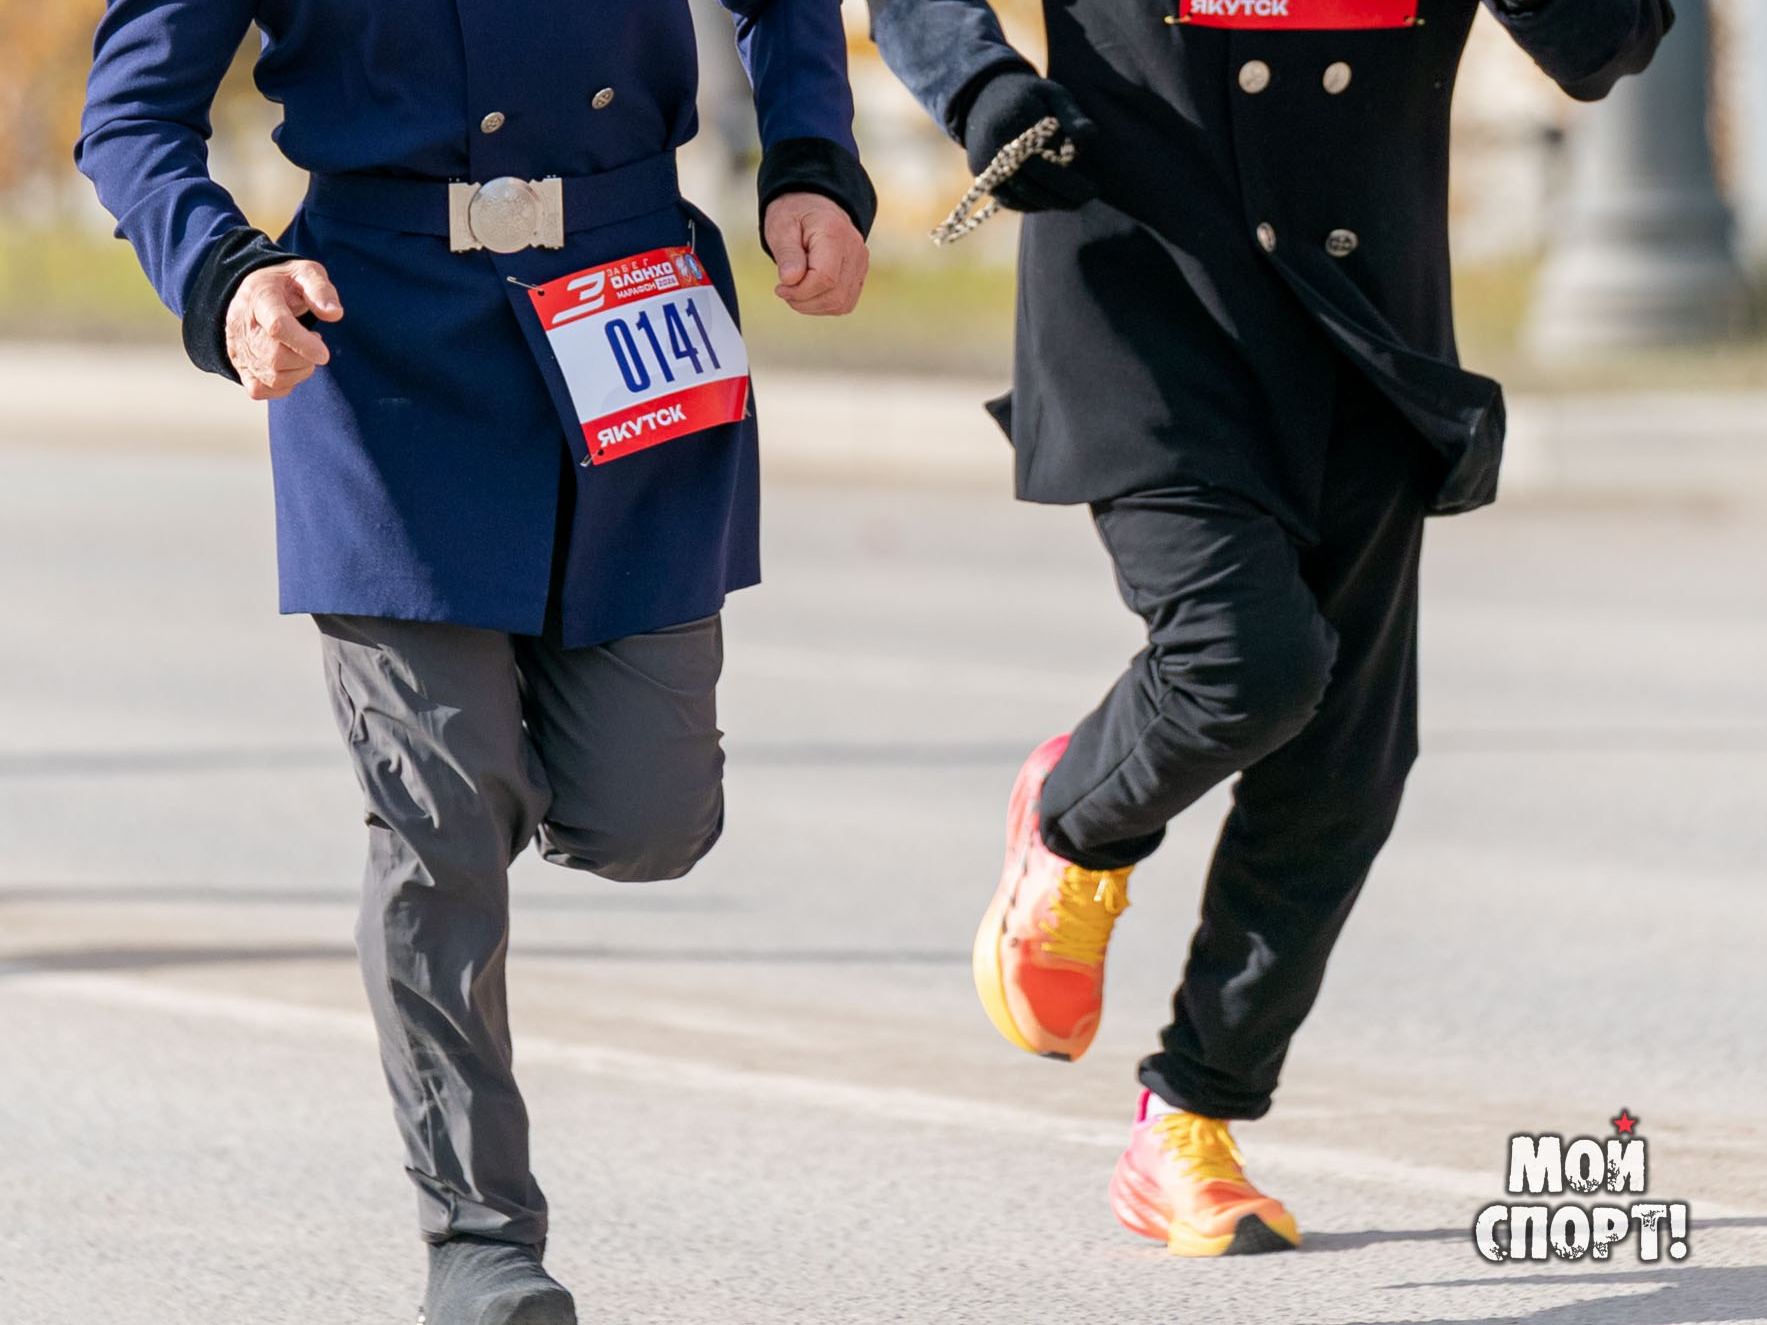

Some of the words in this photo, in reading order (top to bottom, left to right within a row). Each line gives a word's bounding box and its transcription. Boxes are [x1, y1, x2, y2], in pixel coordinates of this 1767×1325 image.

[606, 258, 649, 277] ЗАБЕГ
[610, 261, 674, 289] ОЛОНХО
[616, 281, 657, 299] МАРАФОН
[604, 297, 722, 394] 0141
[597, 403, 687, 448] ЯКУТСК
